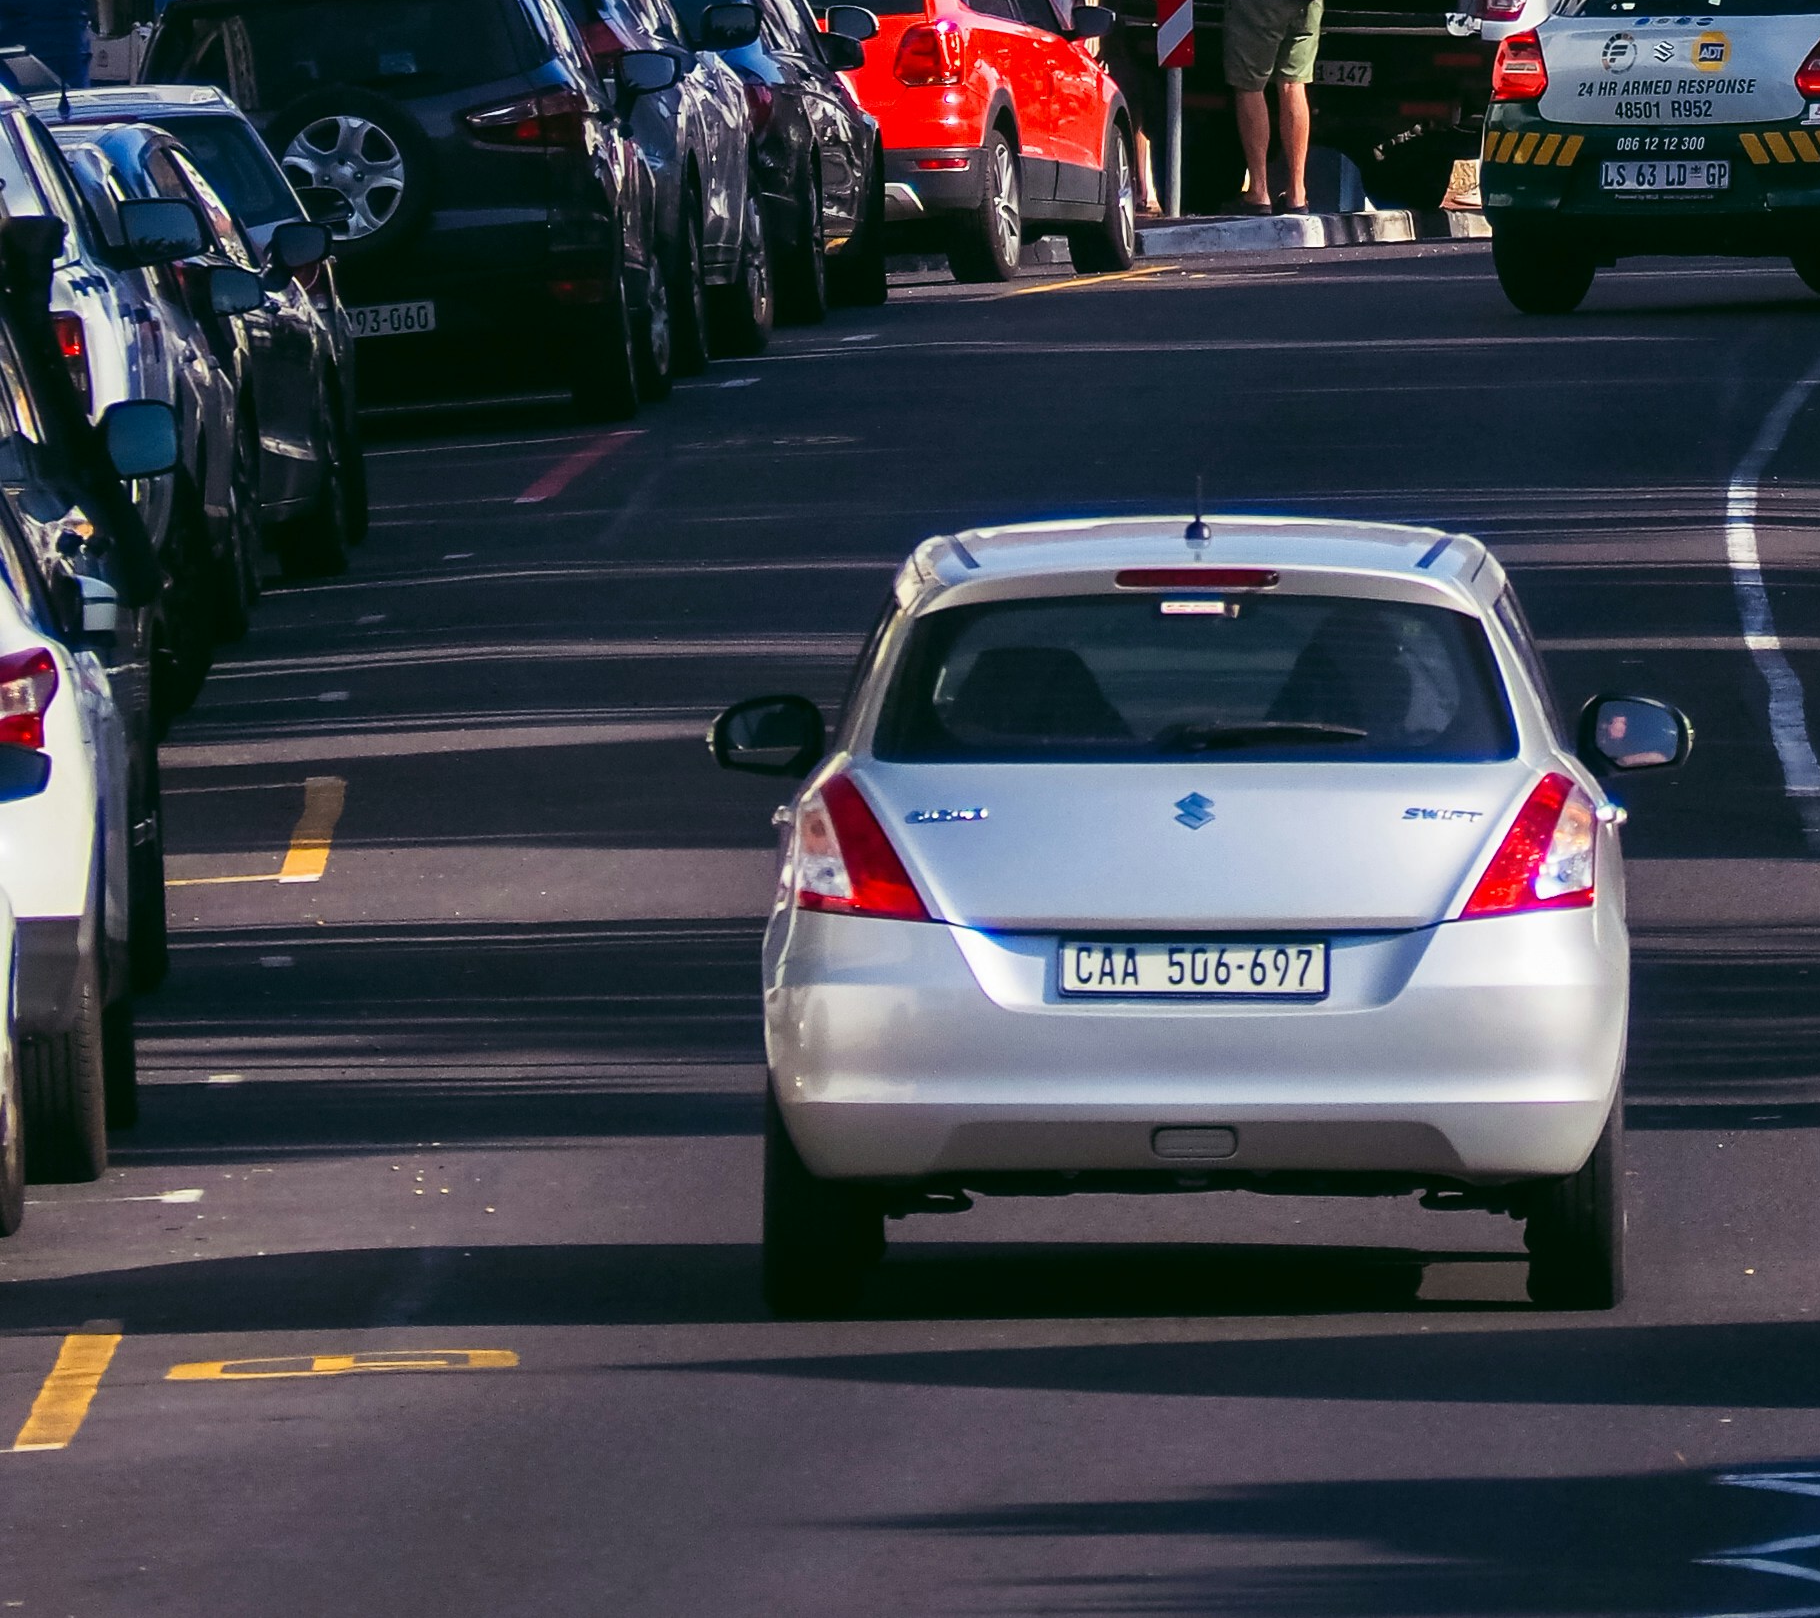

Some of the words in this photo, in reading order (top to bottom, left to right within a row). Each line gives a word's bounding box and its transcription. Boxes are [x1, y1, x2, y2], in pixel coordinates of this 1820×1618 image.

[1700, 44, 1724, 59] ADT
[1578, 82, 1594, 97] 24
[1598, 81, 1617, 96] HR
[1621, 79, 1672, 96] ARMED
[1677, 78, 1757, 95] RESPONSE
[1614, 102, 1661, 119] 48501
[1671, 100, 1713, 118] R952
[1616, 137, 1639, 151] 086
[1644, 137, 1658, 151] 12
[1663, 137, 1677, 151] 12
[1681, 136, 1706, 151] 300
[1603, 165, 1626, 188] LS
[1636, 164, 1657, 187] 63
[1665, 164, 1687, 187] LD
[1706, 163, 1728, 187] GP
[1402, 807, 1483, 823] SWIFT
[1074, 949, 1140, 986] CAA
[1166, 948, 1313, 987] 506-697
